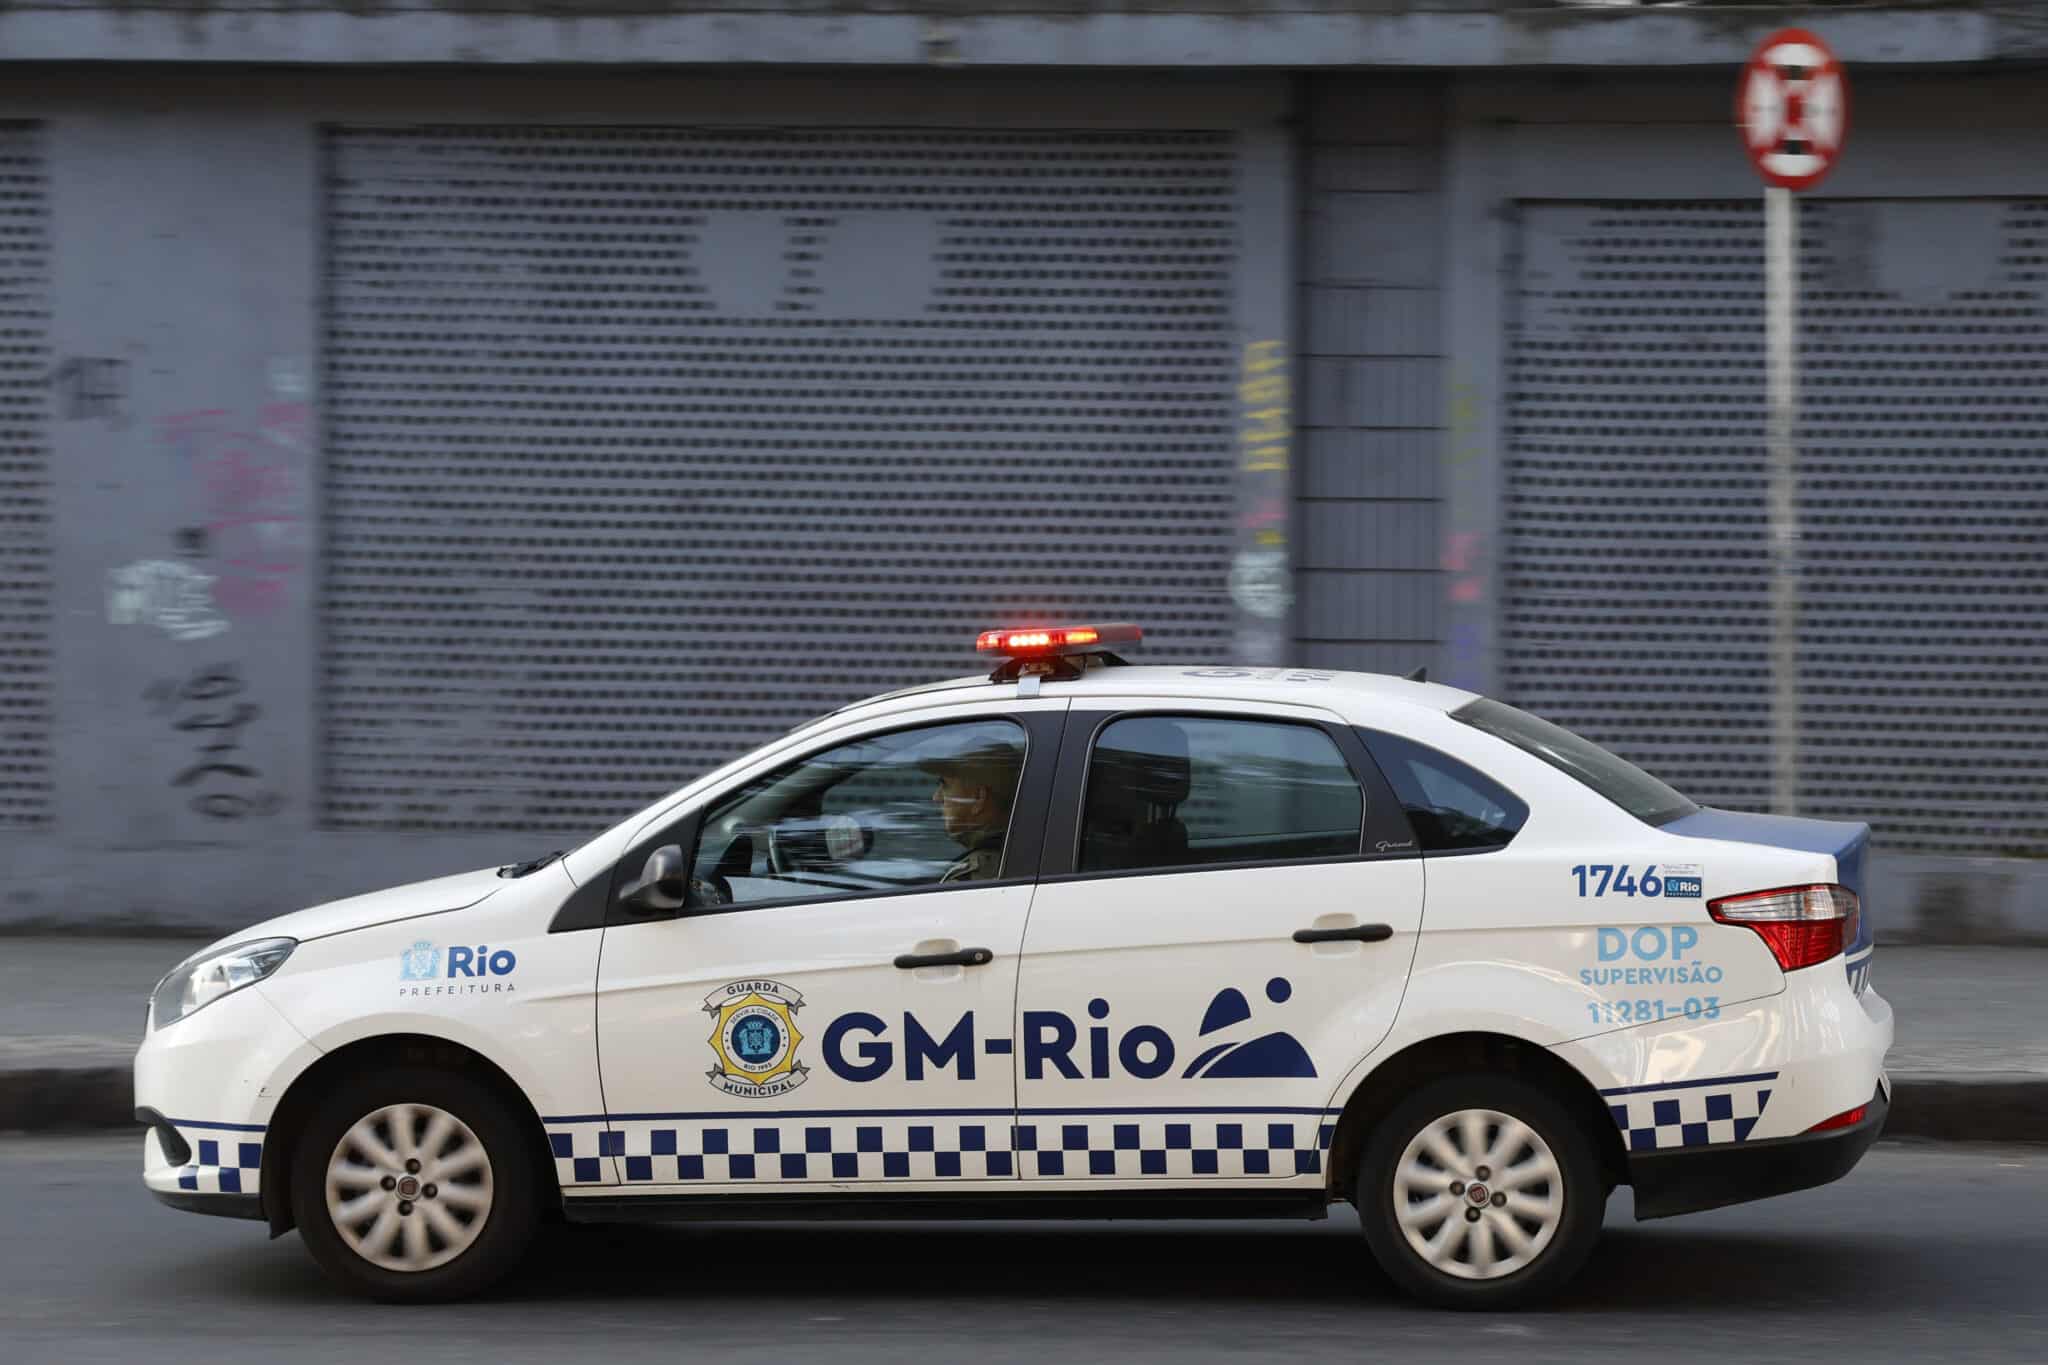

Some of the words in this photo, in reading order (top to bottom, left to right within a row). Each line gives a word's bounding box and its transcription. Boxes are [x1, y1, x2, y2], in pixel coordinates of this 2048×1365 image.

[1571, 864, 1664, 898] 1746
[1679, 881, 1700, 892] Rio
[1597, 926, 1699, 962] DOP
[447, 944, 517, 979] Rio
[1579, 960, 1723, 987] SUPERVISÃO
[399, 983, 516, 997] PREFEITURA
[726, 982, 780, 995] GUARDA
[1586, 996, 1721, 1025] 11281-03
[723, 1080, 796, 1097] MUNICIPAL
